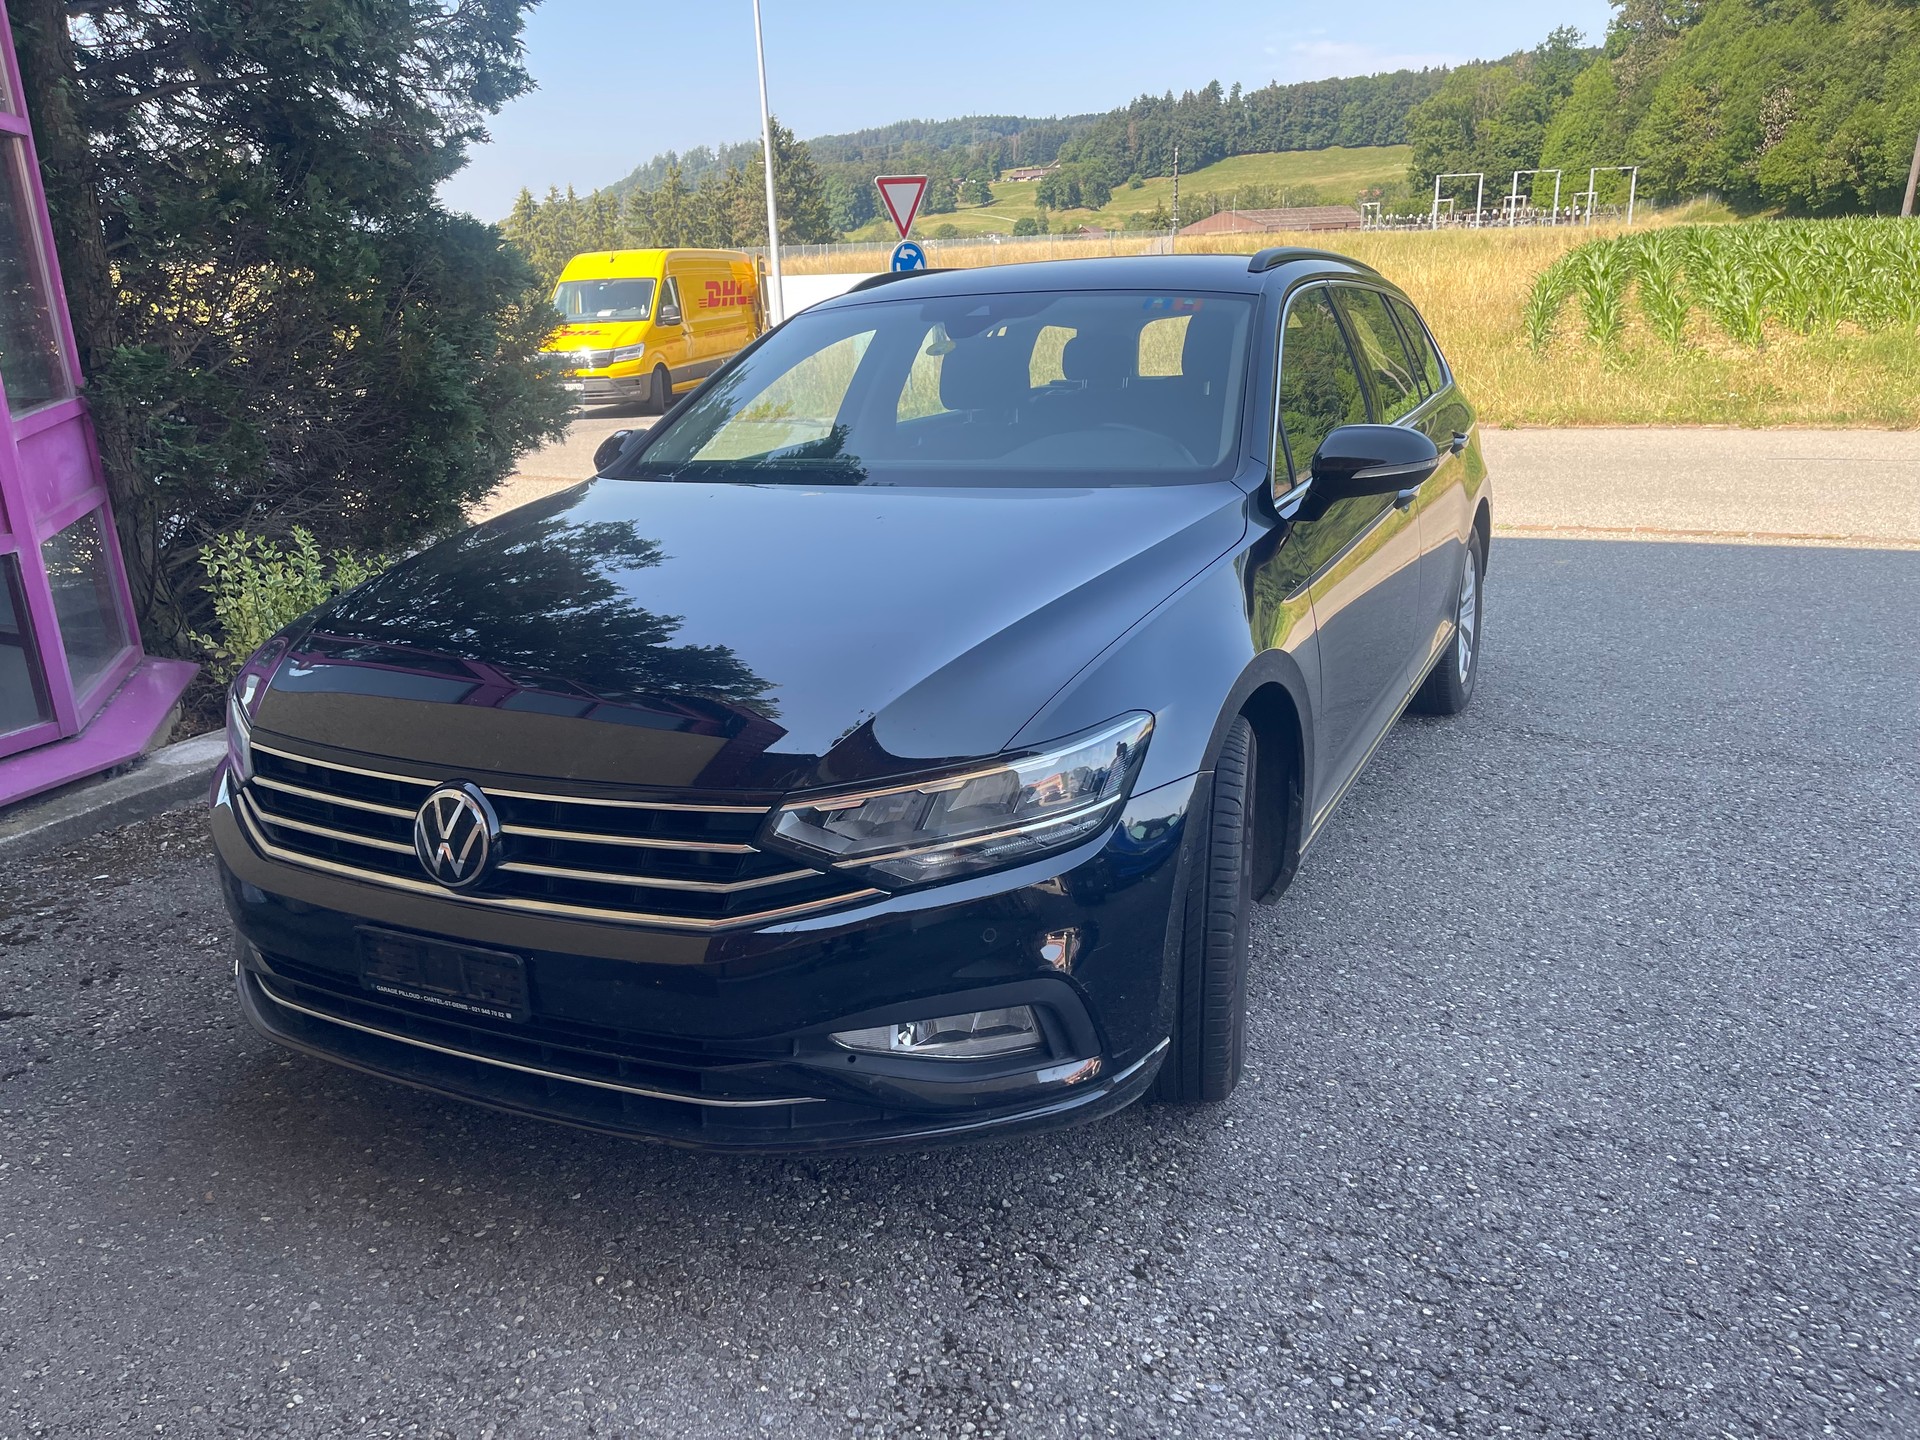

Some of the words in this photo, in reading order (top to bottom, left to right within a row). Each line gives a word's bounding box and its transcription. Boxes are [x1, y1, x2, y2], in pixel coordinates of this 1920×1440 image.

[704, 280, 748, 308] DHL
[376, 985, 398, 995] GARAGE
[398, 990, 420, 999] PILLOUD
